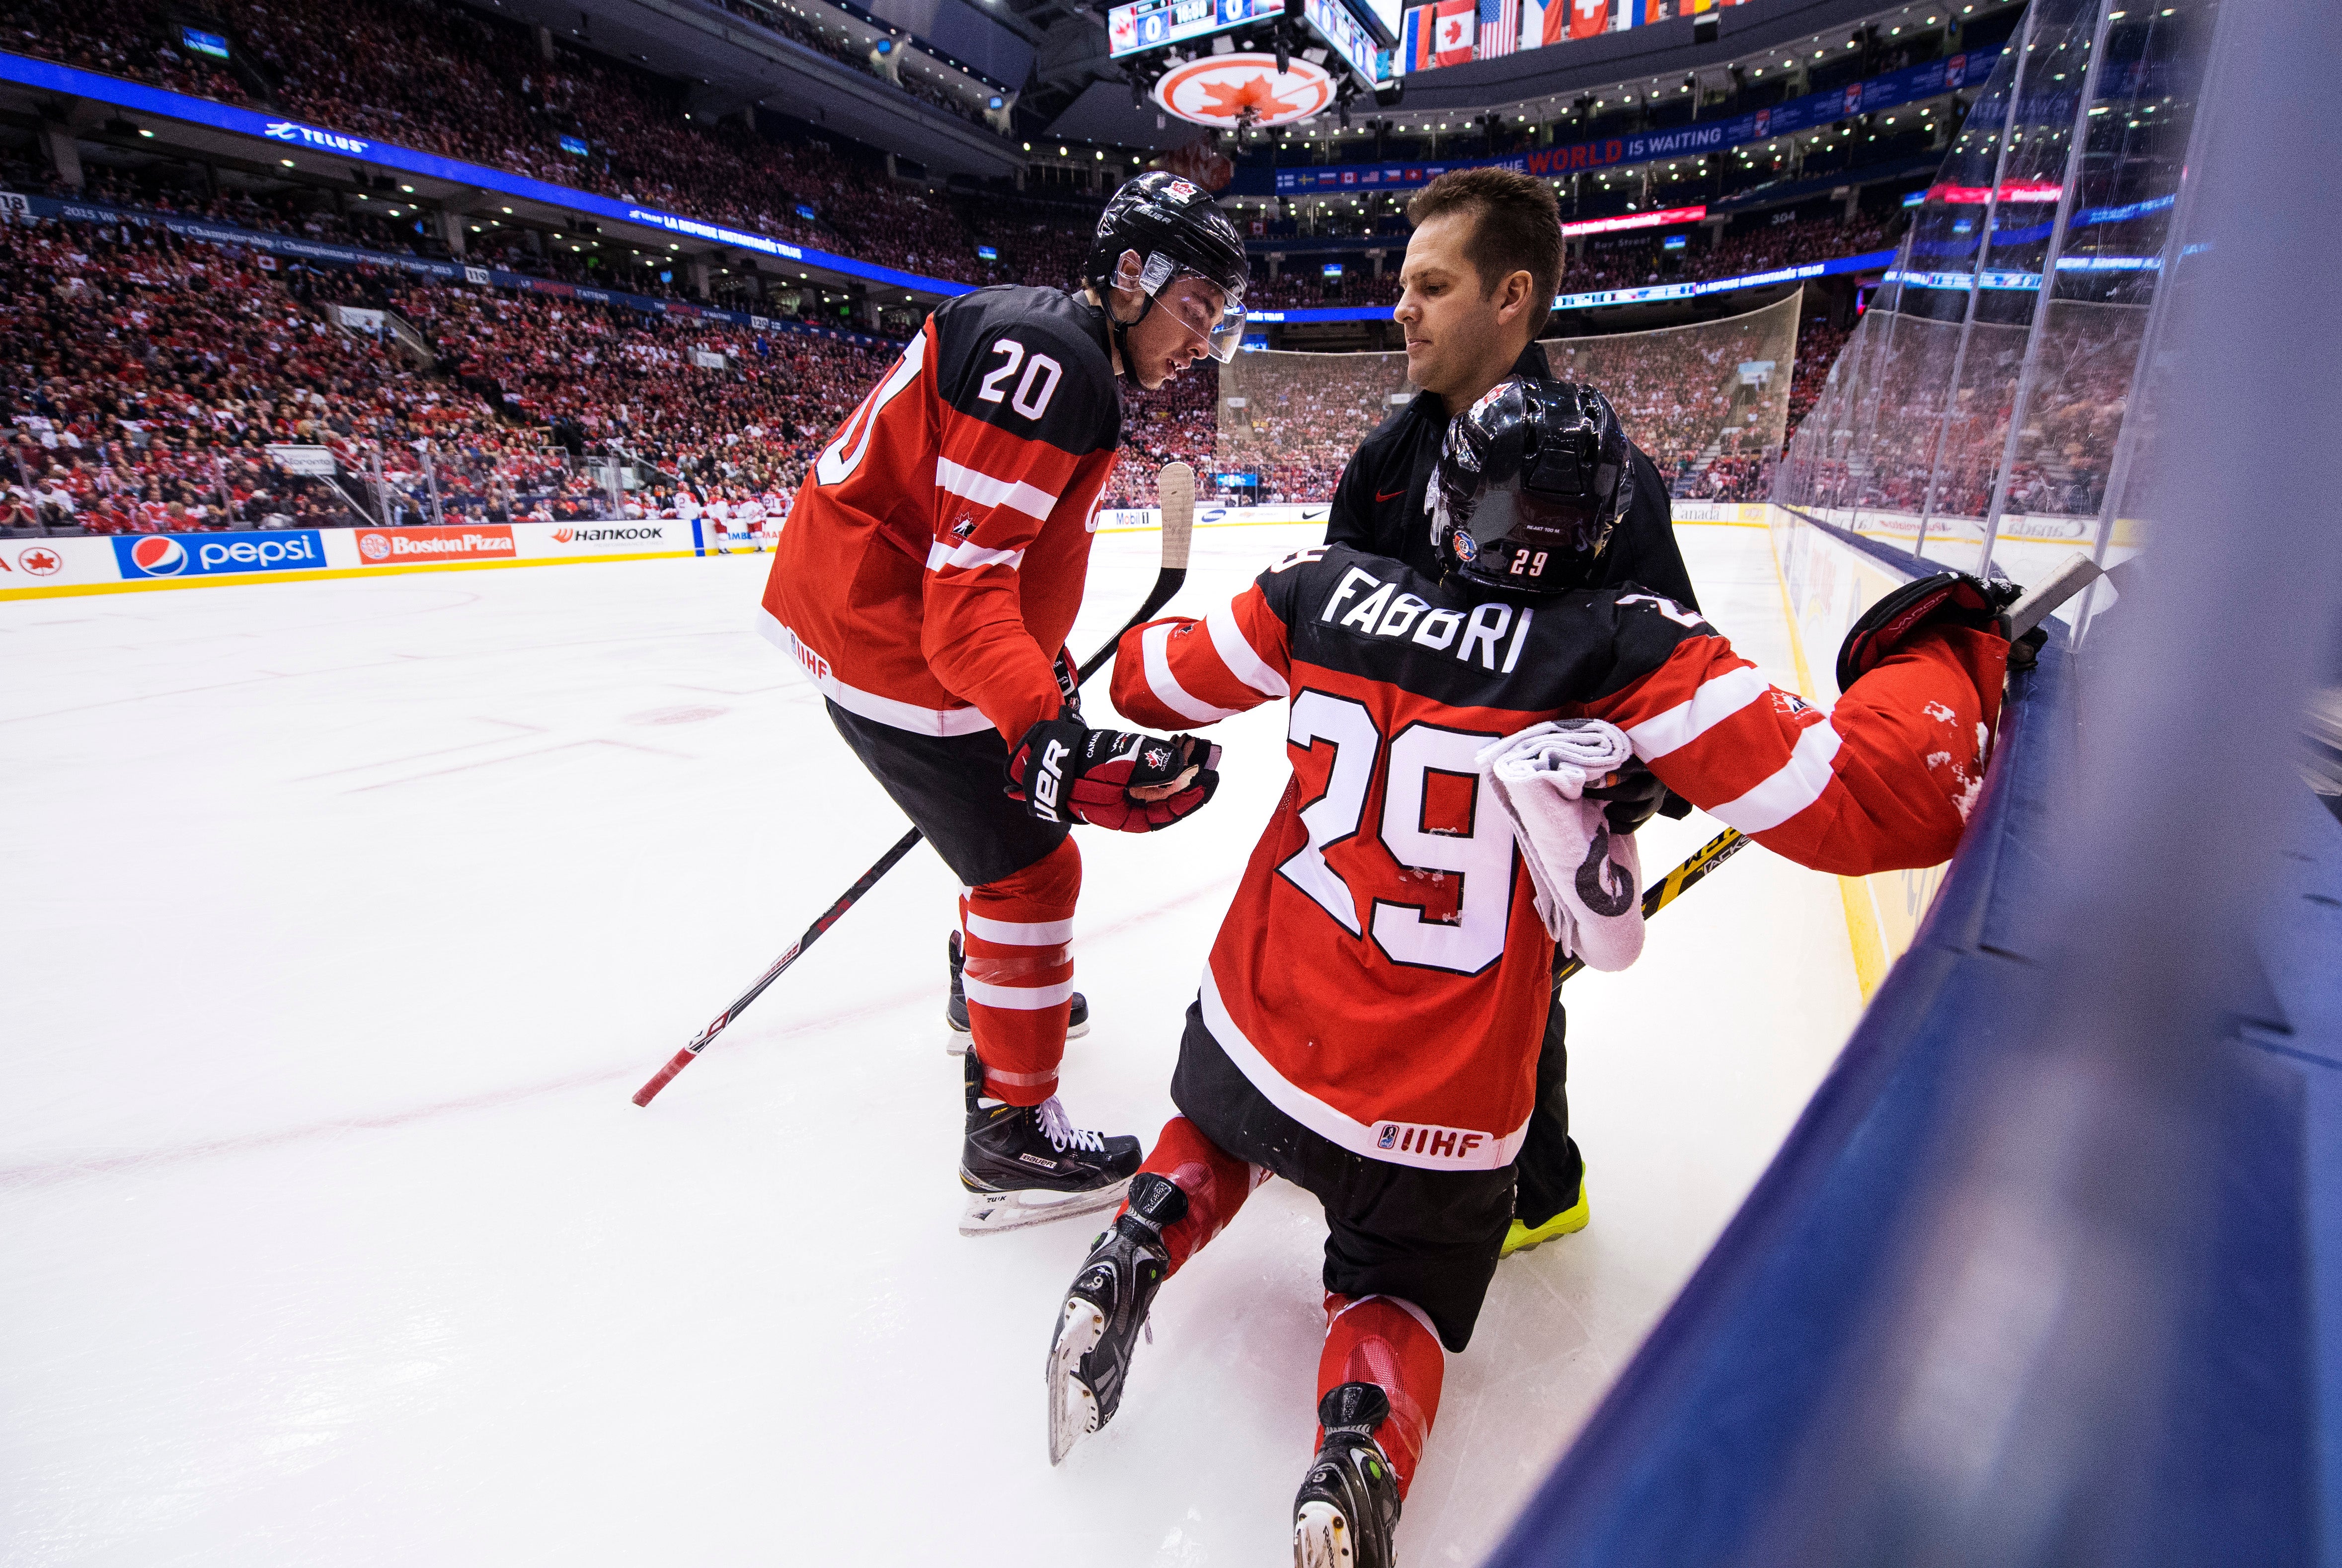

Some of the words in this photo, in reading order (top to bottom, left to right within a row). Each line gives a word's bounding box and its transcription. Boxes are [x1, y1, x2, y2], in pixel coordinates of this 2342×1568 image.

[1145, 15, 1162, 42] 0
[300, 127, 362, 153] TELUS
[1527, 140, 1623, 175] WORLD
[1628, 141, 1644, 157] IS
[1648, 127, 1722, 154] WAITING
[663, 216, 679, 230] LA
[678, 219, 718, 239] REPRISE
[718, 229, 778, 253] INSTANTANÉE
[776, 242, 802, 260] TELUS
[1797, 264, 1825, 278] TELUS
[979, 338, 1063, 421] 20
[1116, 512, 1140, 525] Mobil
[1142, 512, 1149, 524] 1
[1671, 503, 1719, 520] Canada
[200, 535, 316, 570] pepsi
[1510, 549, 1549, 577] 29
[1321, 565, 1534, 673] FABBRI
[797, 640, 827, 680] IIHF
[1087, 731, 1103, 758] CANADA
[1275, 687, 1518, 975] 29
[1703, 835, 1753, 875] TACKS
[1401, 1127, 1483, 1158] IIHF
[1023, 1154, 1054, 1167] BAUER
[1323, 1525, 1335, 1568] Reeb
